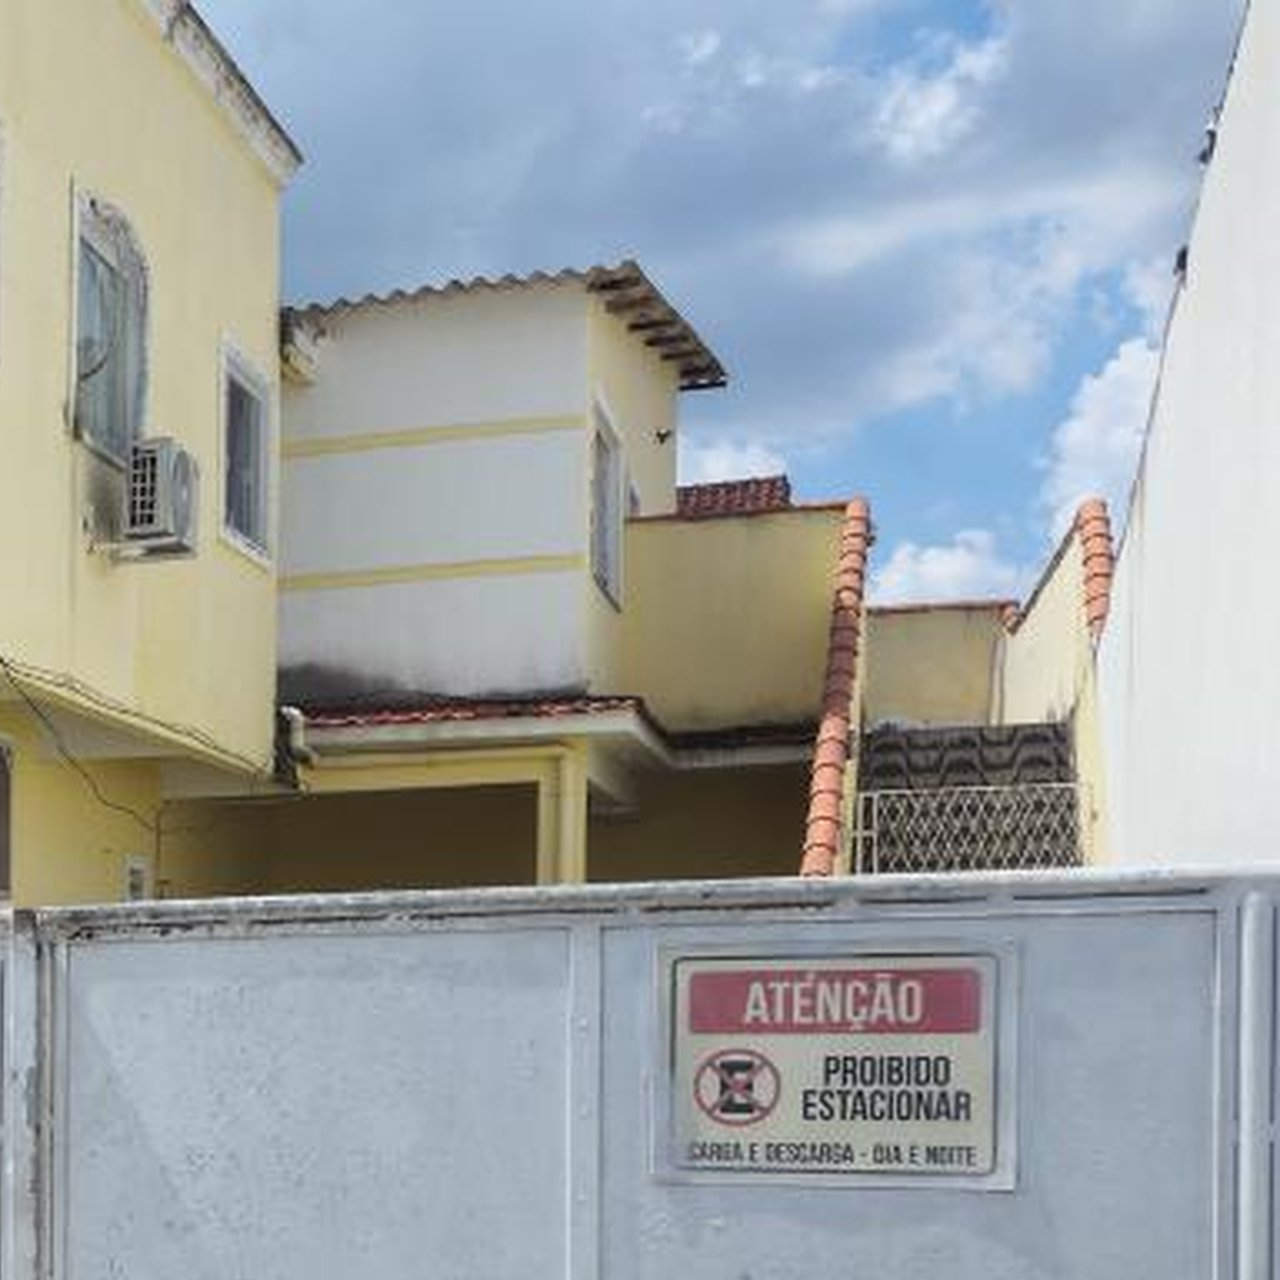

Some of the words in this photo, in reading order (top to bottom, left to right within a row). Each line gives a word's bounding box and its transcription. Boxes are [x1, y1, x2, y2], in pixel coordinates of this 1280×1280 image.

[743, 973, 923, 1031] ATENÇÃO
[823, 1055, 952, 1087] PROIBIDO
[801, 1089, 972, 1122] ESTACIONAR
